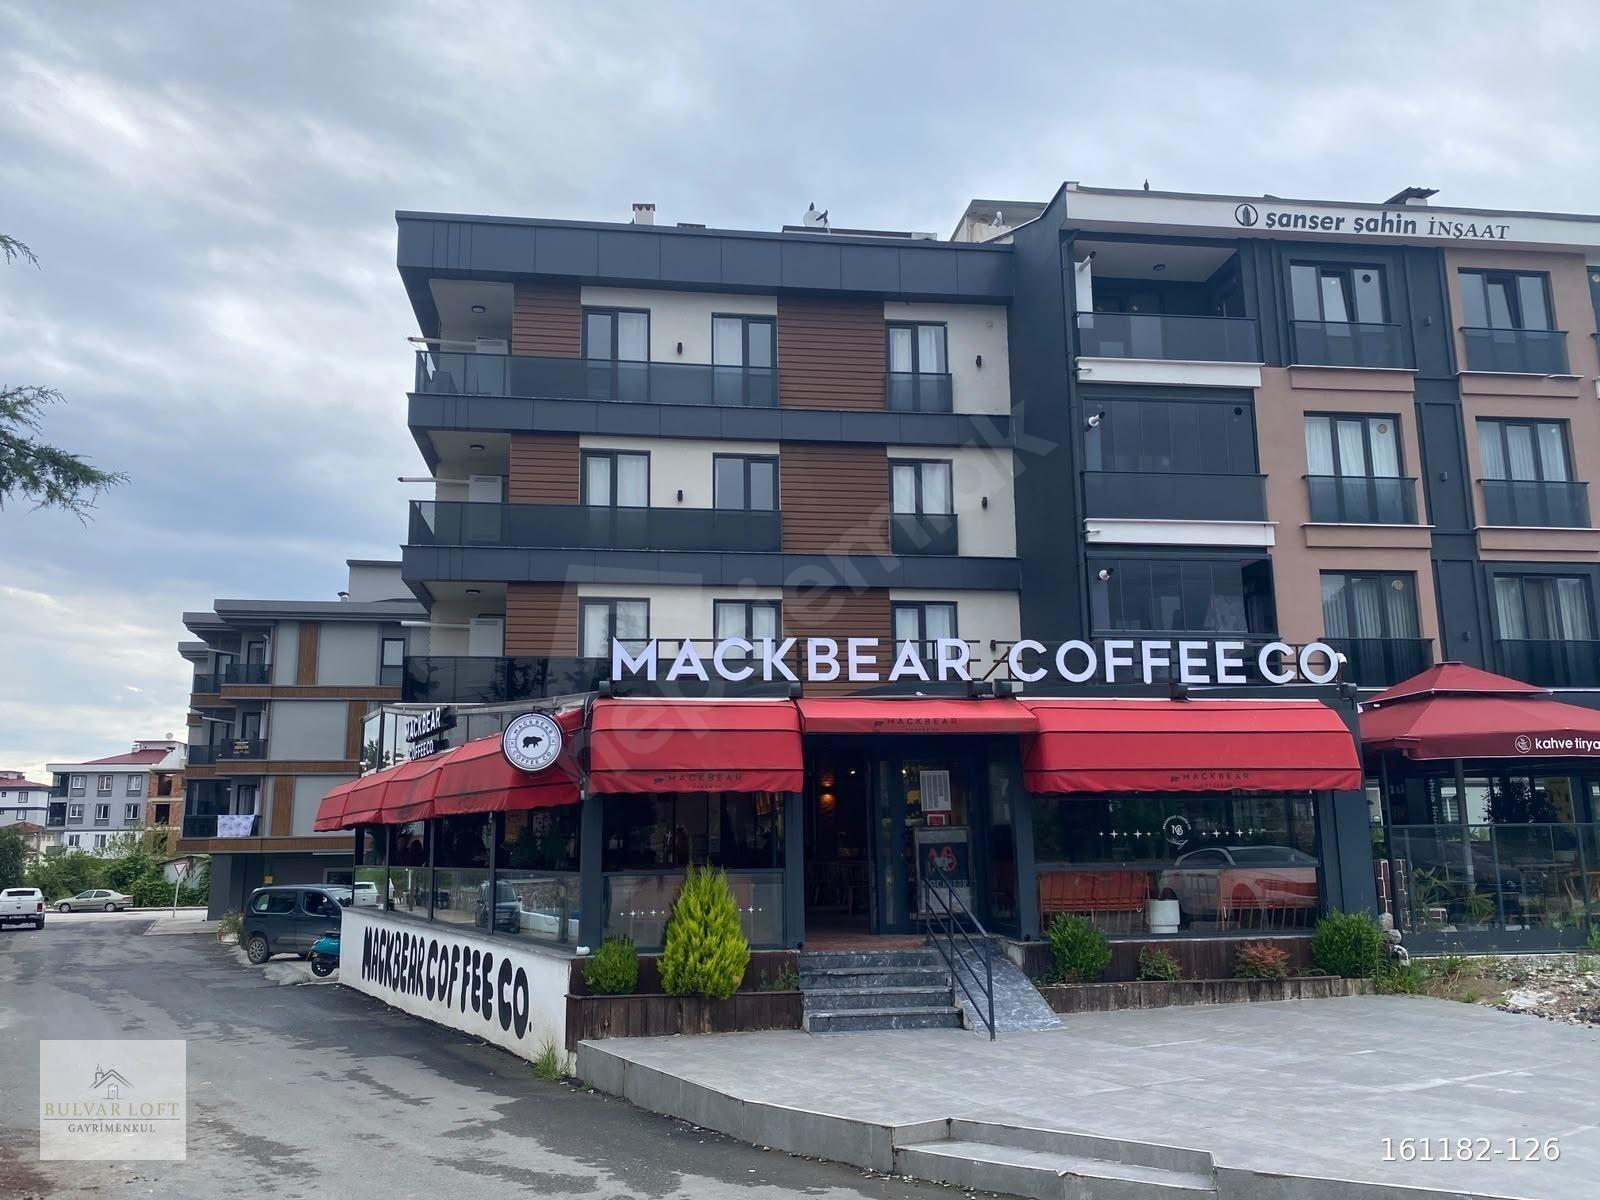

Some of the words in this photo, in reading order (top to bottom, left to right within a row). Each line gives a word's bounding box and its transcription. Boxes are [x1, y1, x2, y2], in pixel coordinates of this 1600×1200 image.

[1265, 210, 1345, 230] şanser
[1353, 211, 1417, 234] şahin
[1427, 216, 1510, 239] İNŞAAT
[612, 636, 973, 682] MACKBEAR
[1008, 639, 1247, 684] COFFEE
[1258, 641, 1339, 684] CO
[1535, 737, 1574, 750] kahve
[362, 926, 425, 997] MACKBEAR
[426, 939, 494, 1022] COFFEE
[497, 958, 532, 1040] CO.
